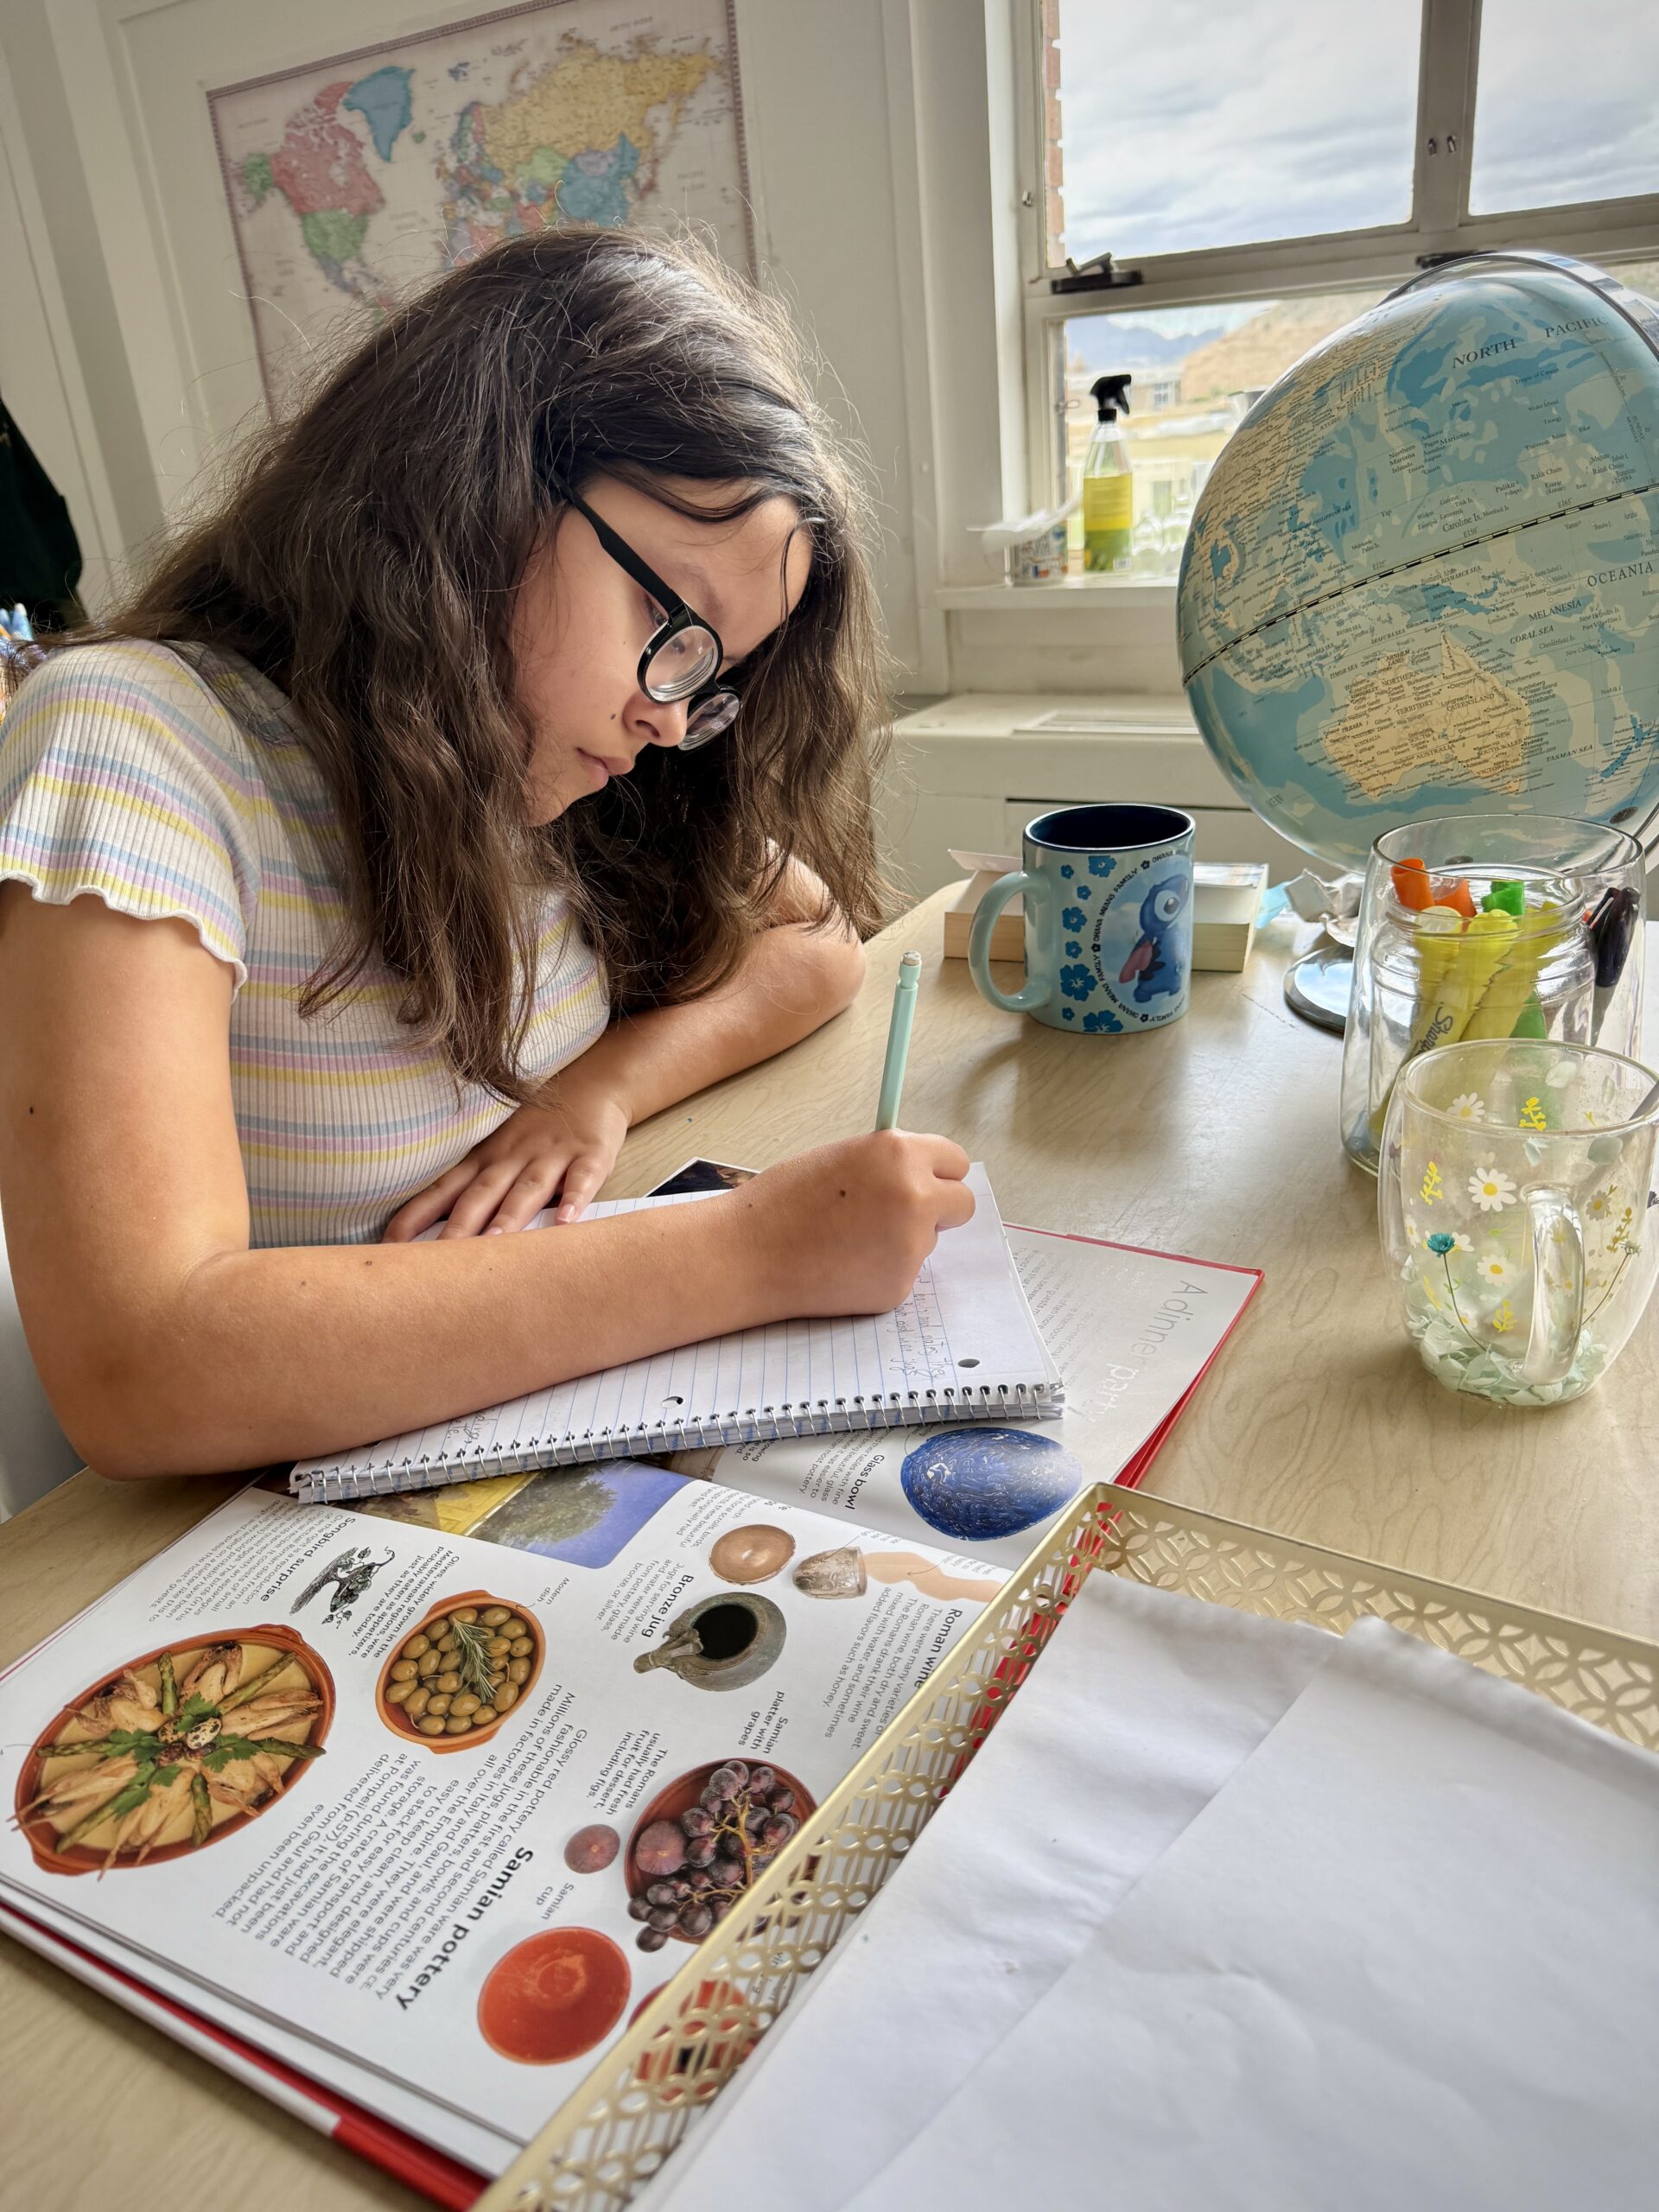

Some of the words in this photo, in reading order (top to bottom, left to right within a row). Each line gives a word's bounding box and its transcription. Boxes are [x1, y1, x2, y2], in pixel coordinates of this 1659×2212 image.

[1452, 339, 1516, 368] NORTH
[1545, 315, 1609, 338] PACIFIC
[1440, 431, 1470, 445] Marianas
[1389, 445, 1415, 459] Northern
[1389, 453, 1415, 466] Mariana
[1392, 462, 1412, 474] Islands
[1547, 467, 1562, 476] Chain
[1495, 482, 1516, 493] Palikir
[1443, 517, 1471, 532] Caroline
[1471, 565, 1480, 575] SEA
[1587, 562, 1653, 587] OCEANIA
[1526, 589, 1547, 598] Honiara
[1529, 599, 1581, 621] MELANESIA
[1466, 639, 1492, 651] Cooktown
[1510, 632, 1537, 644] CORAL
[1539, 625, 1554, 635] SEA
[1386, 650, 1410, 661] ARNHEM
[1388, 658, 1404, 666] LAND
[1471, 648, 1489, 658] Cairns
[1478, 653, 1505, 665] Townsville
[1330, 670, 1347, 679] TIMOR
[1382, 671, 1419, 685] NORTHERN
[1443, 669, 1473, 680] Normanton
[1491, 665, 1512, 674] Mackay
[1507, 671, 1541, 684] Rockhampton
[1518, 681, 1546, 691] Bundaberg
[1396, 700, 1433, 715] TERRITORY
[1442, 695, 1469, 706] Longreach
[1446, 694, 1494, 711] QUEENSLAND
[1528, 694, 1555, 705] Brisbane
[1408, 734, 1430, 742] SOUTH
[1478, 747, 1500, 756] SOUTH
[1501, 740, 1522, 750] WALES
[1417, 745, 1455, 760] AUSTRALIA
[1547, 750, 1578, 762] TASMAN
[1580, 745, 1593, 753] SEA
[1476, 763, 1509, 775] VICTORIA
[1153, 851, 1173, 863] OHANA
[1093, 919, 1103, 941] OHANA
[1100, 893, 1116, 917] MEANS
[1115, 868, 1138, 893] FAMILY
[1093, 955, 1106, 981] FAMILY
[1102, 982, 1118, 1004] MEANS
[1119, 1003, 1139, 1019] OHANA
[1416, 1006, 1453, 1056] Sharp
[1178, 1281, 1209, 1296] A
[1130, 1298, 1195, 1368] dinner
[1066, 1362, 1140, 1422] party
[814, 1445, 833, 1464] most
[859, 1453, 885, 1478] Glass
[798, 1462, 819, 1494] pottery.
[838, 1471, 851, 1487] with
[820, 1478, 835, 1502] glass
[831, 1487, 845, 1505] fine
[843, 1478, 867, 1510] bowl
[302, 1516, 356, 1557] Songbird
[403, 1549, 453, 1603] Mediterranean
[433, 1554, 460, 1579] Olives,
[657, 1558, 672, 1573] and
[665, 1561, 684, 1580] Jugs
[259, 1557, 305, 1602] surprise
[544, 1576, 570, 1605] Modern
[641, 1573, 661, 1595] water
[657, 1580, 671, 1592] for
[412, 1580, 437, 1606] widely
[536, 1586, 551, 1602] dish
[626, 1594, 645, 1615] were
[657, 1573, 695, 1615] Bronze
[634, 1592, 661, 1623] serving
[901, 1598, 918, 1612] The
[906, 1602, 930, 1631] Roman
[375, 1603, 406, 1637] regions,
[391, 1605, 416, 1633] grown
[610, 1614, 631, 1640] made
[640, 1613, 665, 1637] jug
[883, 1612, 909, 1648] Romans
[929, 1607, 963, 1653] Roman
[385, 1633, 397, 1642] in
[622, 1623, 640, 1643] wine
[893, 1631, 912, 1654] wine,
[359, 1637, 380, 1659] were
[372, 1643, 389, 1658] the
[869, 1647, 889, 1675] drank
[883, 1655, 903, 1679] both
[912, 1656, 937, 1691] wine
[859, 1675, 877, 1698] their
[874, 1679, 889, 1697] dry
[541, 1691, 575, 1735] Millions
[762, 1690, 785, 1726] platter
[847, 1700, 864, 1723] wine
[866, 1696, 880, 1718] and
[737, 1710, 760, 1745] grapes
[749, 1727, 767, 1750] with
[761, 1716, 788, 1754] Samian
[849, 1717, 871, 1749] sweet.
[532, 1736, 545, 1751] of
[555, 1728, 588, 1768] Glossy
[630, 1729, 650, 1752] fruit
[634, 1732, 660, 1767] usually
[523, 1723, 574, 1789] fashionable
[599, 1731, 635, 1777] including
[620, 1752, 636, 1768] for
[649, 1749, 668, 1767] The
[508, 1751, 537, 1783] these
[541, 1767, 560, 1789] red
[622, 1767, 642, 1789] had
[486, 1781, 515, 1809] jugs,
[512, 1789, 529, 1801] in
[586, 1777, 607, 1798] figs.
[593, 1769, 624, 1808] dessert,
[624, 1768, 656, 1809] Romans
[498, 1802, 519, 1822] the
[508, 1788, 545, 1834] pottery
[605, 1789, 628, 1815] fresh
[296, 1803, 324, 1830] even
[448, 1809, 492, 1856] platters,
[477, 1823, 503, 1847] first
[268, 1830, 302, 1859] been
[480, 1834, 512, 1870] called
[459, 1847, 481, 1872] and
[416, 1858, 456, 1894] bowls,
[466, 1846, 534, 1921] Samian
[211, 1859, 272, 1918] unpacked.
[423, 1871, 463, 1916] second
[445, 1868, 487, 1913] Samian
[535, 1885, 553, 1906] cup
[397, 1896, 422, 1922] and
[540, 1882, 575, 1920] Samian
[371, 1921, 401, 1953] cups
[420, 1914, 450, 1944] ware
[374, 1915, 426, 1974] centuries
[344, 1953, 375, 1985] were
[395, 1923, 470, 2011] pottery
[399, 1945, 424, 1970] was
[374, 1971, 404, 2000] very
